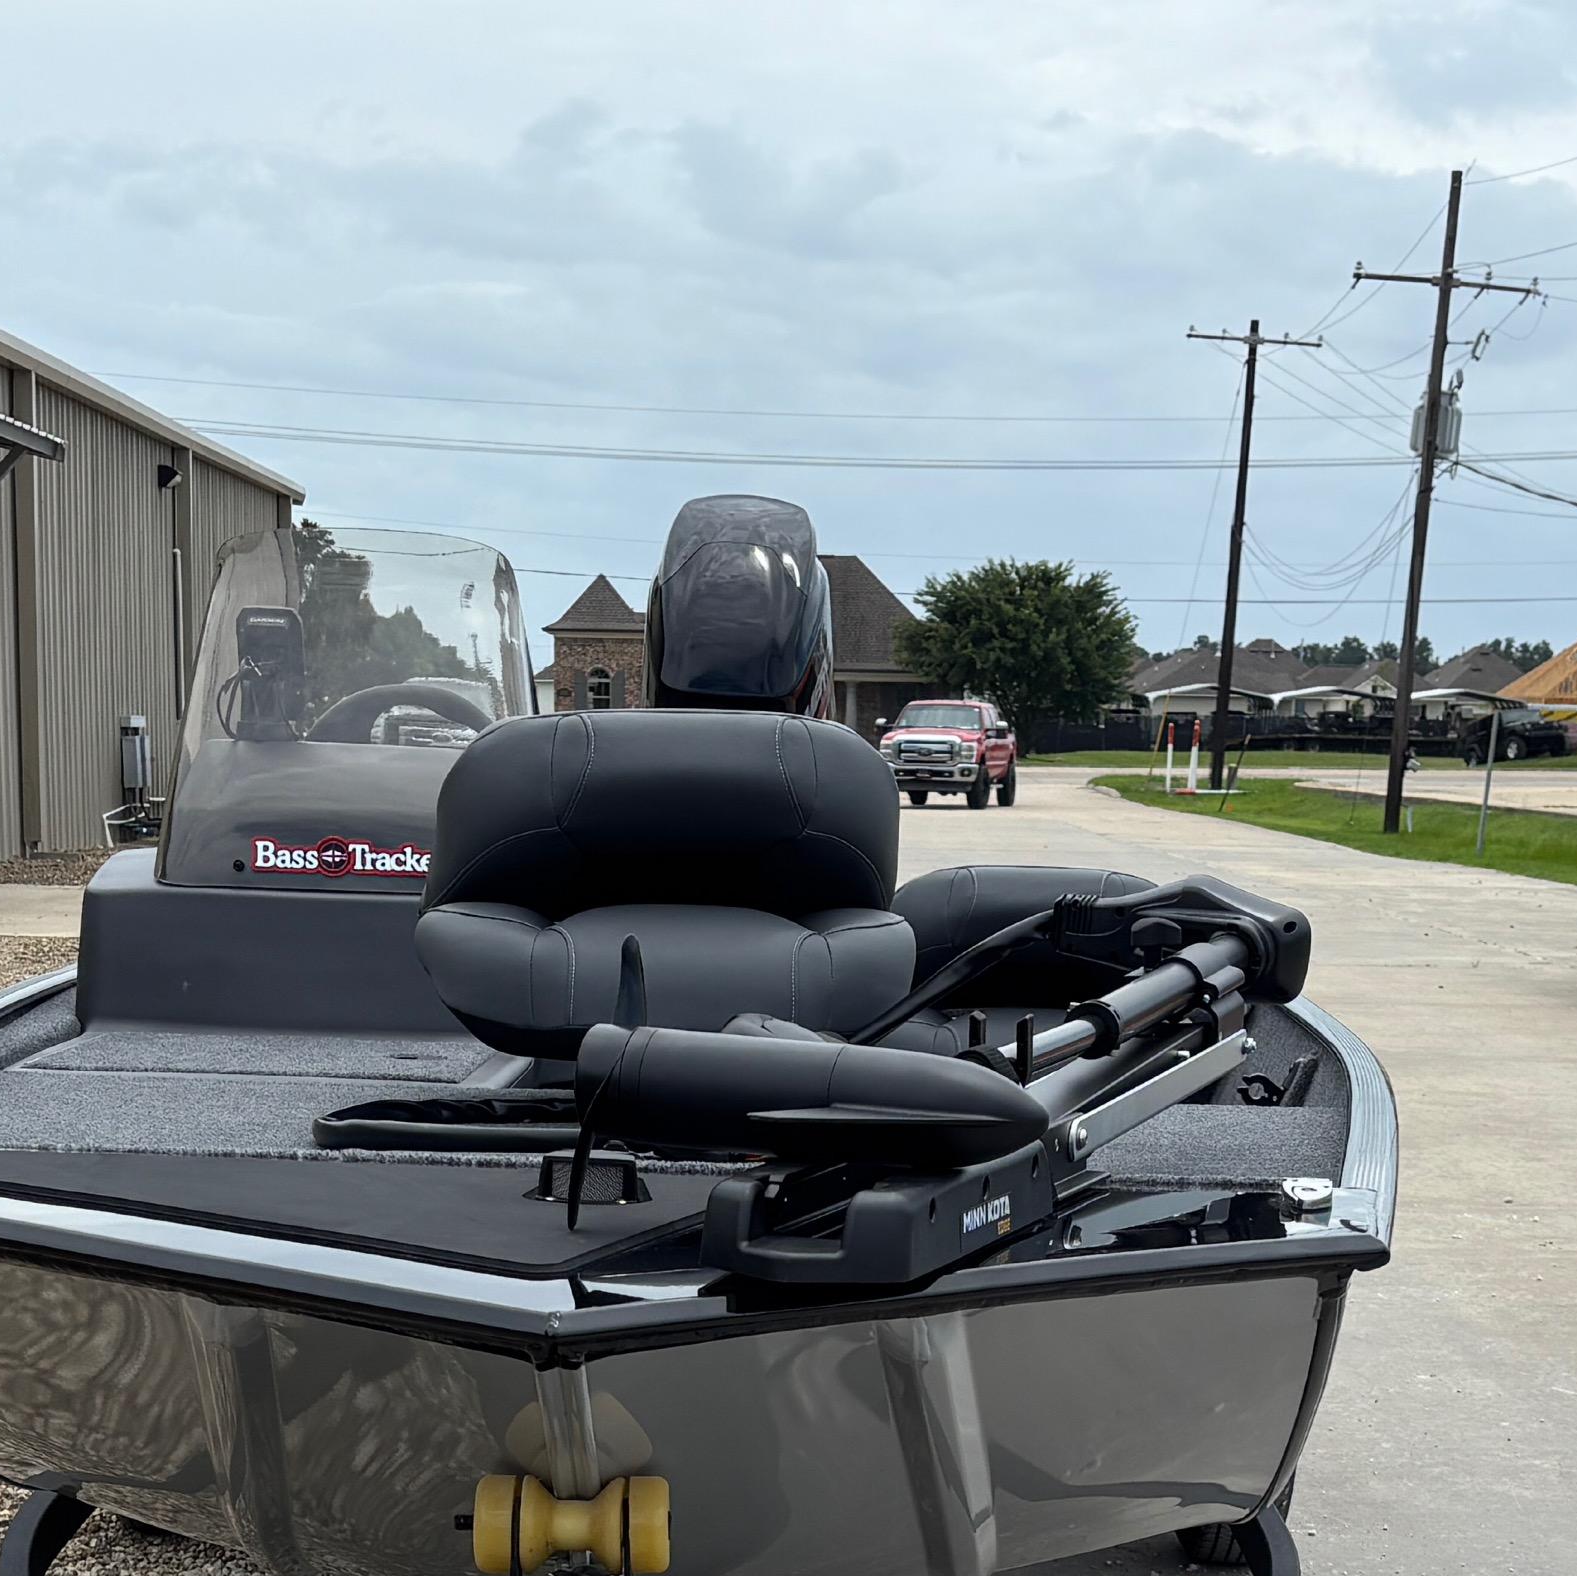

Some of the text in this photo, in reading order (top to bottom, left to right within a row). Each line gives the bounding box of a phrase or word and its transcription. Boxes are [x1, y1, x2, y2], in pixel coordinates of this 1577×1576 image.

[254, 840, 431, 872] Bass Tracke
[963, 1195, 1011, 1233] MINN KOTA
